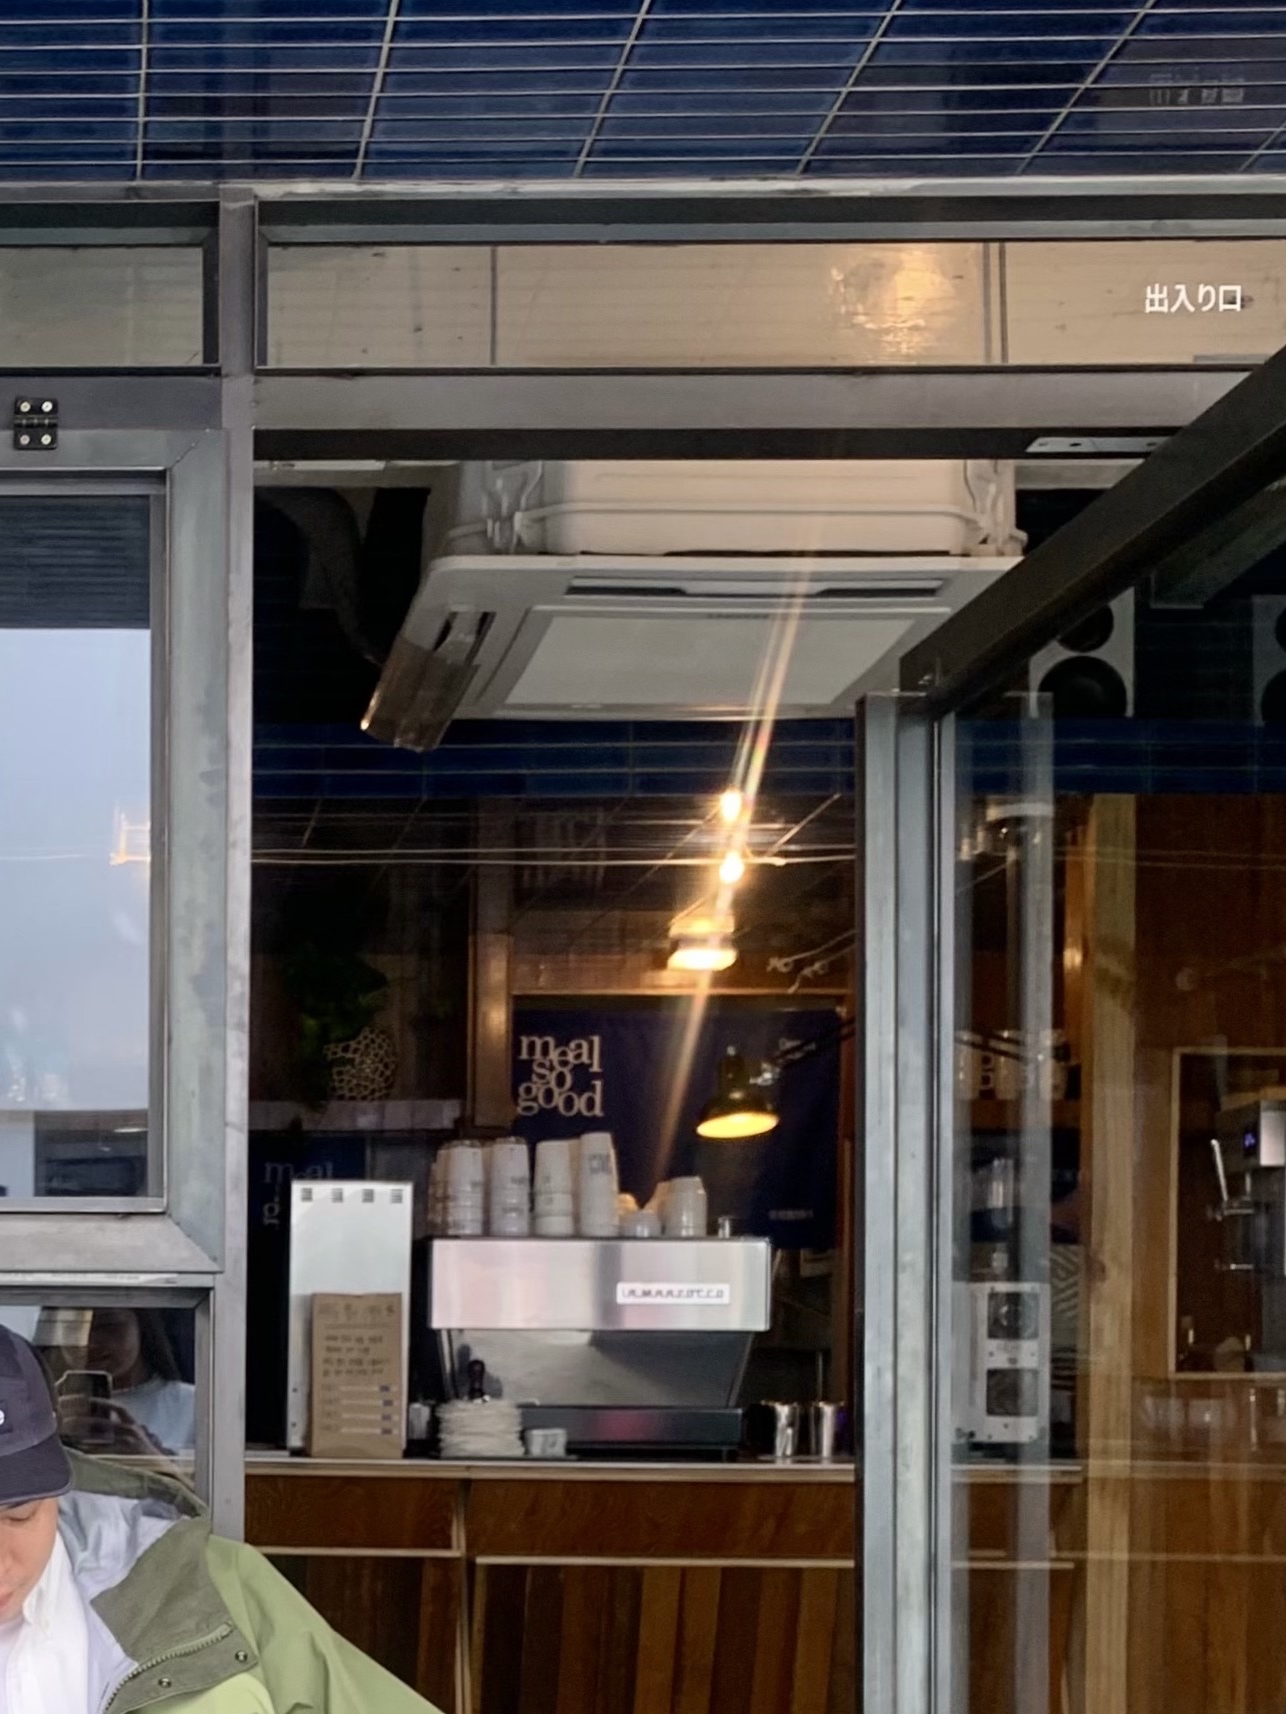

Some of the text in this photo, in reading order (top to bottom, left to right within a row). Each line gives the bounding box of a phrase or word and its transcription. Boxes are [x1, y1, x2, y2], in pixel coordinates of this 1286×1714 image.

[1145, 283, 1242, 313] 出入り口
[518, 1035, 603, 1072] meal
[531, 1060, 573, 1093] so
[517, 1080, 604, 1117] good
